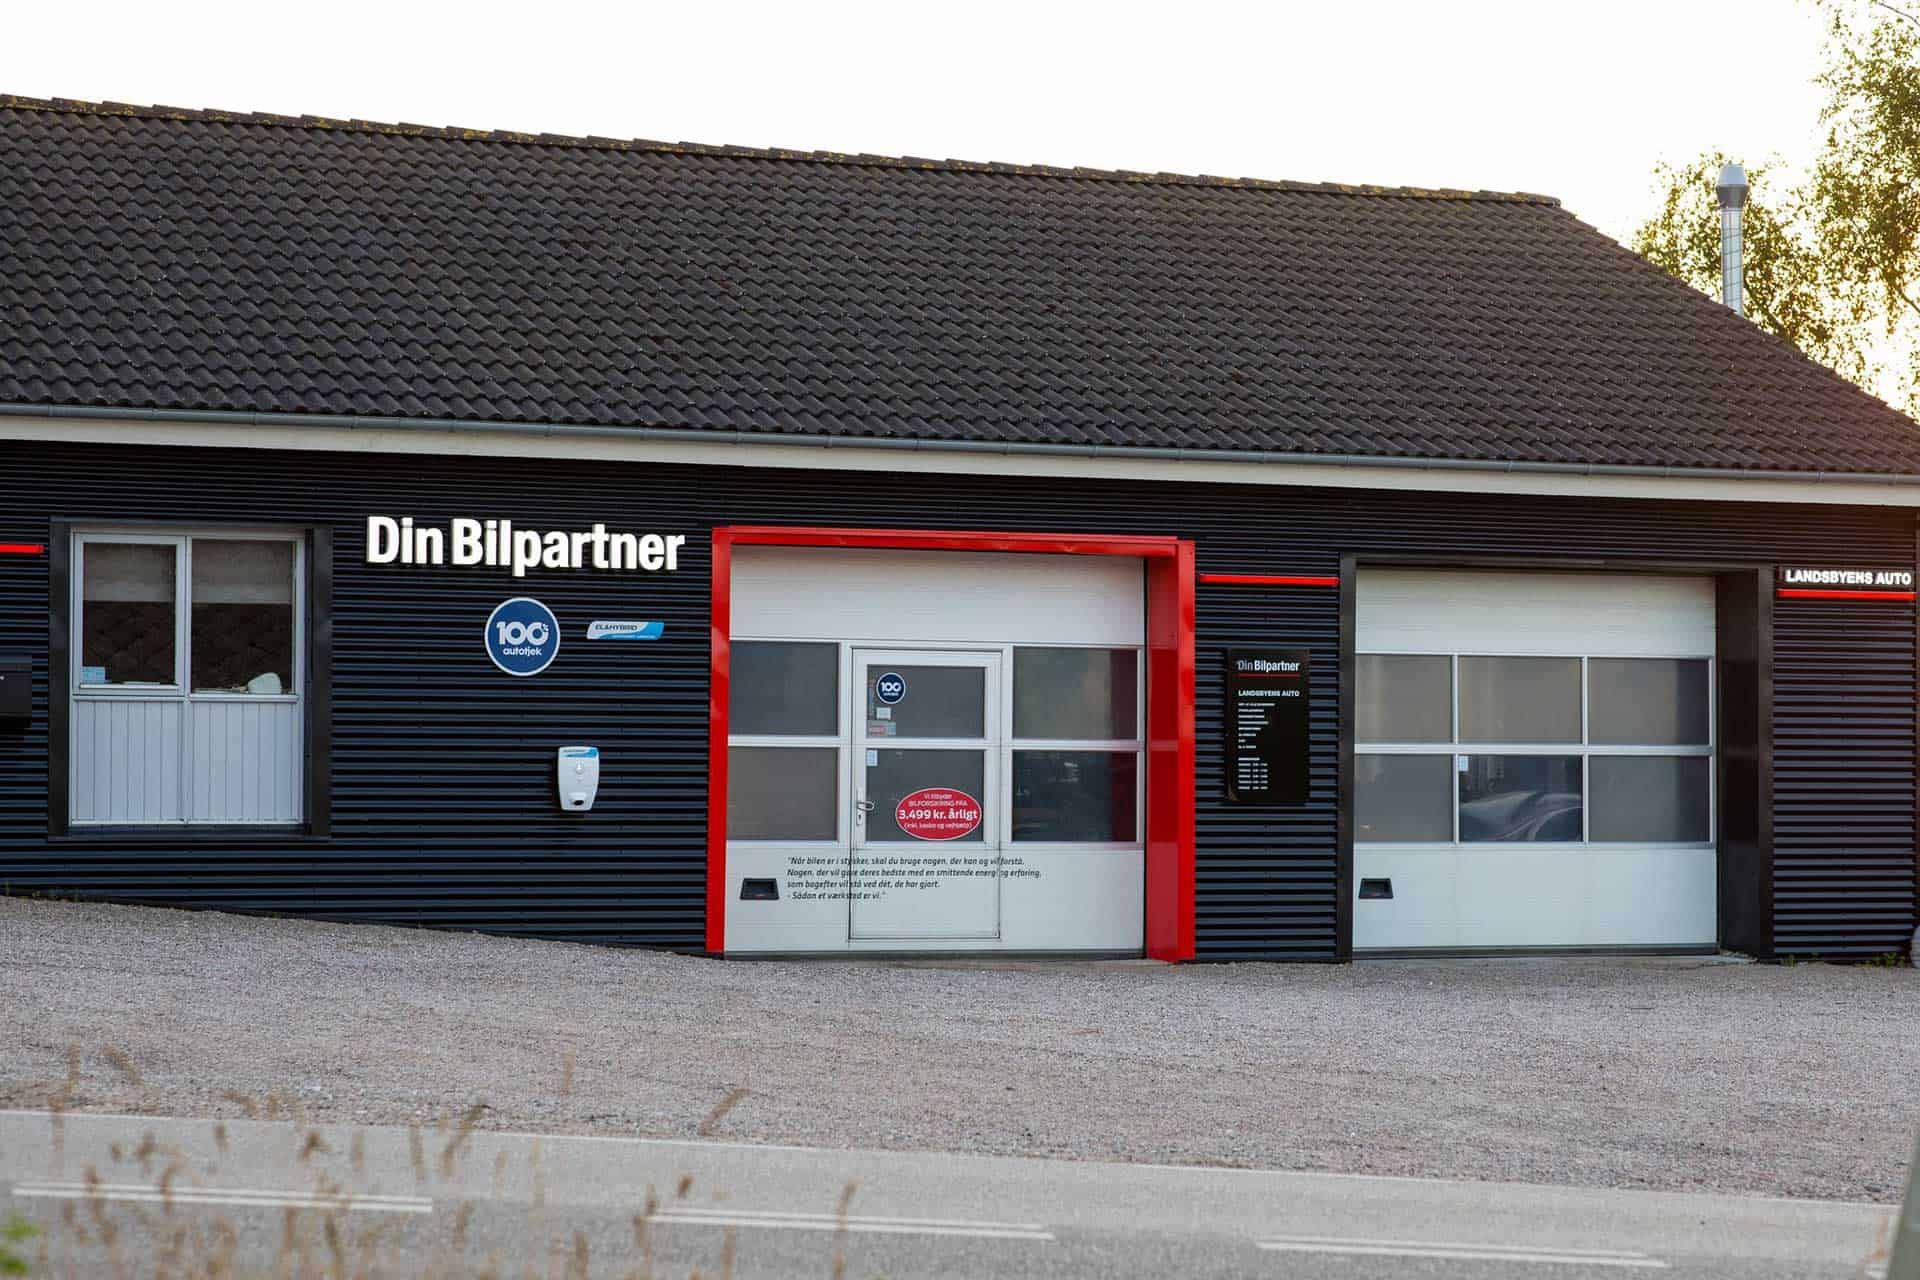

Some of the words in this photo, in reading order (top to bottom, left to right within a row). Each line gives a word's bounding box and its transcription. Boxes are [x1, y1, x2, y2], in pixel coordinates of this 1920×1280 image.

[367, 515, 443, 565] Din
[451, 517, 685, 577] Bilpartner
[1785, 569, 1873, 584] LANDSBYENS
[1875, 572, 1912, 585] AUTO
[503, 647, 542, 656] autotjek
[1238, 660, 1253, 671] Din
[1254, 660, 1300, 673] Bilpartner
[899, 809, 931, 820] 3.499
[933, 809, 946, 819] kr.
[948, 808, 978, 821] årligt
[807, 857, 825, 865] bilen
[871, 857, 887, 865] skal
[888, 857, 898, 865] du
[900, 857, 921, 866] bruge
[950, 857, 962, 865] der
[979, 858, 988, 866] og
[805, 880, 837, 889] bagefter
[863, 880, 877, 888] ved
[895, 880, 904, 888] de
[905, 880, 918, 888] har
